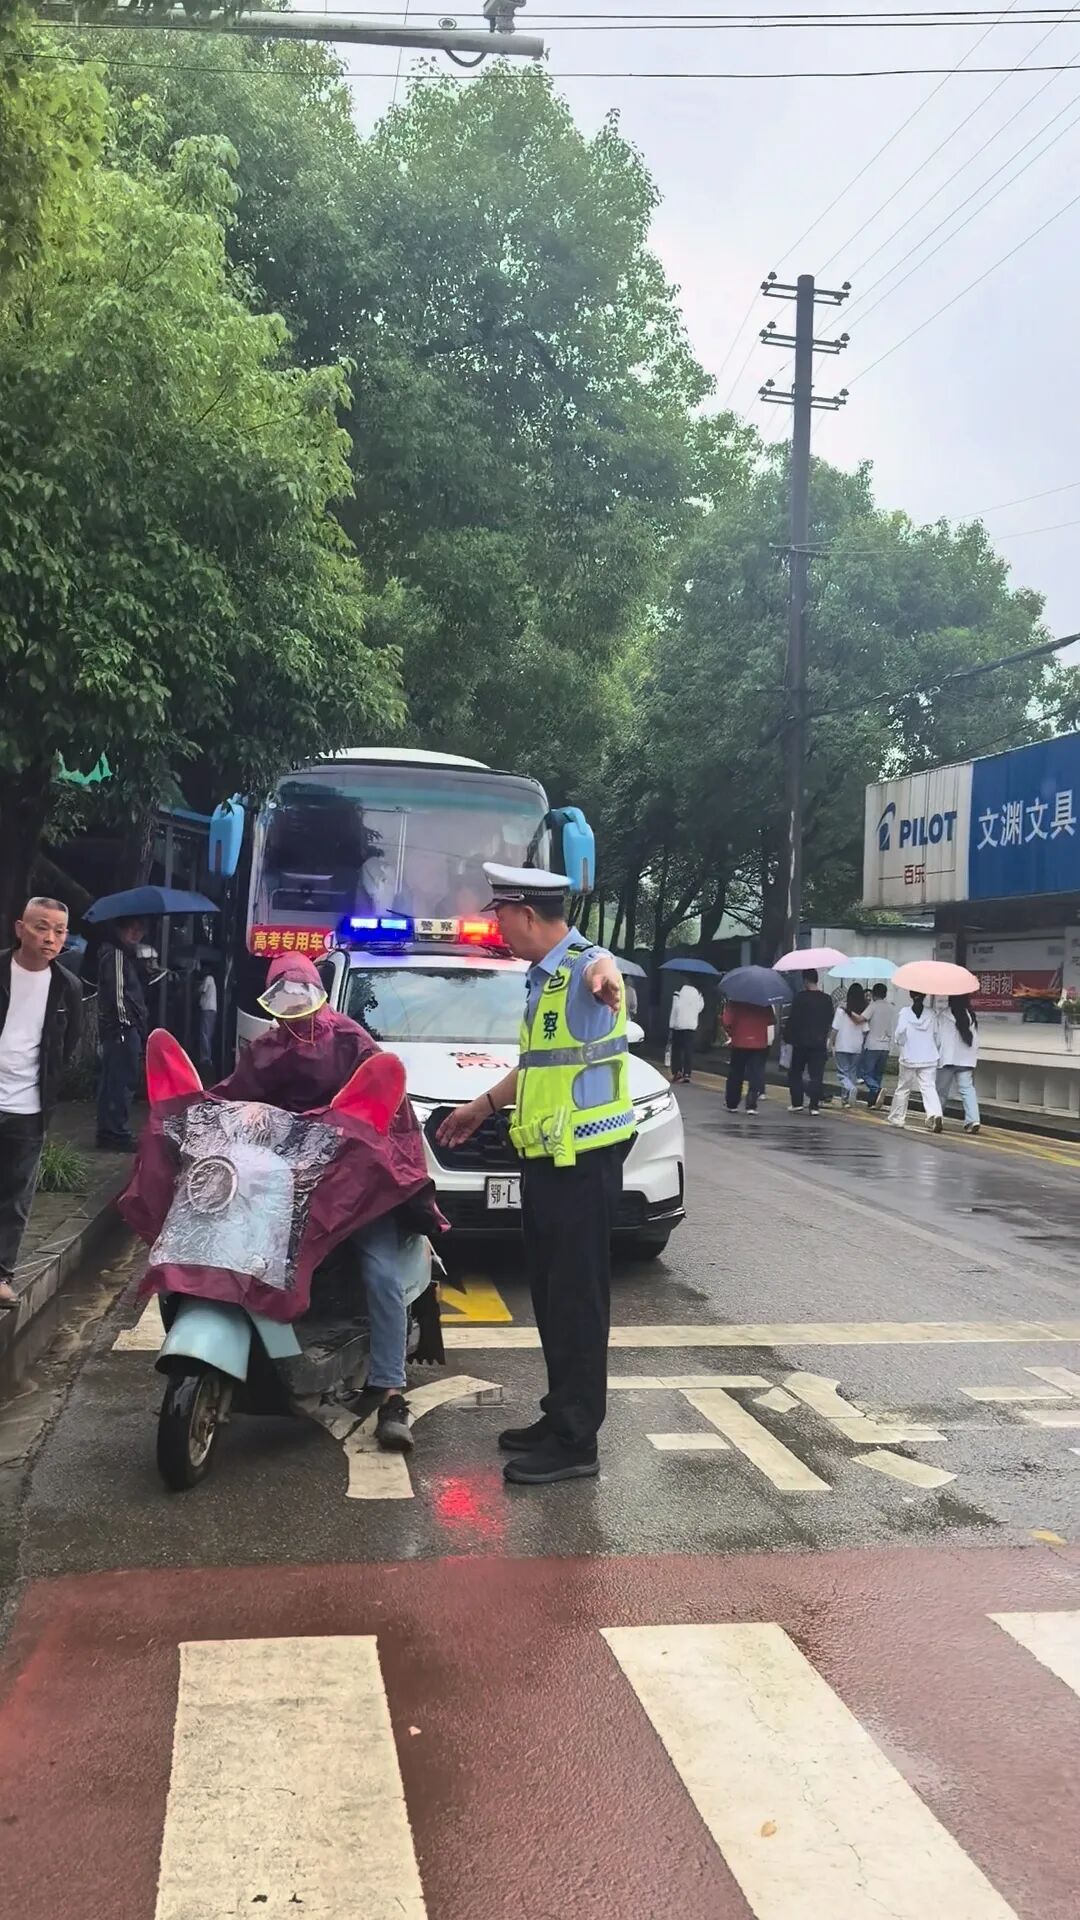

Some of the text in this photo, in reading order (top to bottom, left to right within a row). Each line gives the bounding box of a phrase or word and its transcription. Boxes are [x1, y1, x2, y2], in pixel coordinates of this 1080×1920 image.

[899, 811, 957, 849] PILOT
[977, 789, 1077, 850] 文渊文具
[904, 863, 926, 885] 百乐
[420, 920, 453, 932] 警察
[254, 931, 325, 951] 高考专用车
[980, 972, 1013, 994] 键时刻
[543, 1010, 559, 1040] 察
